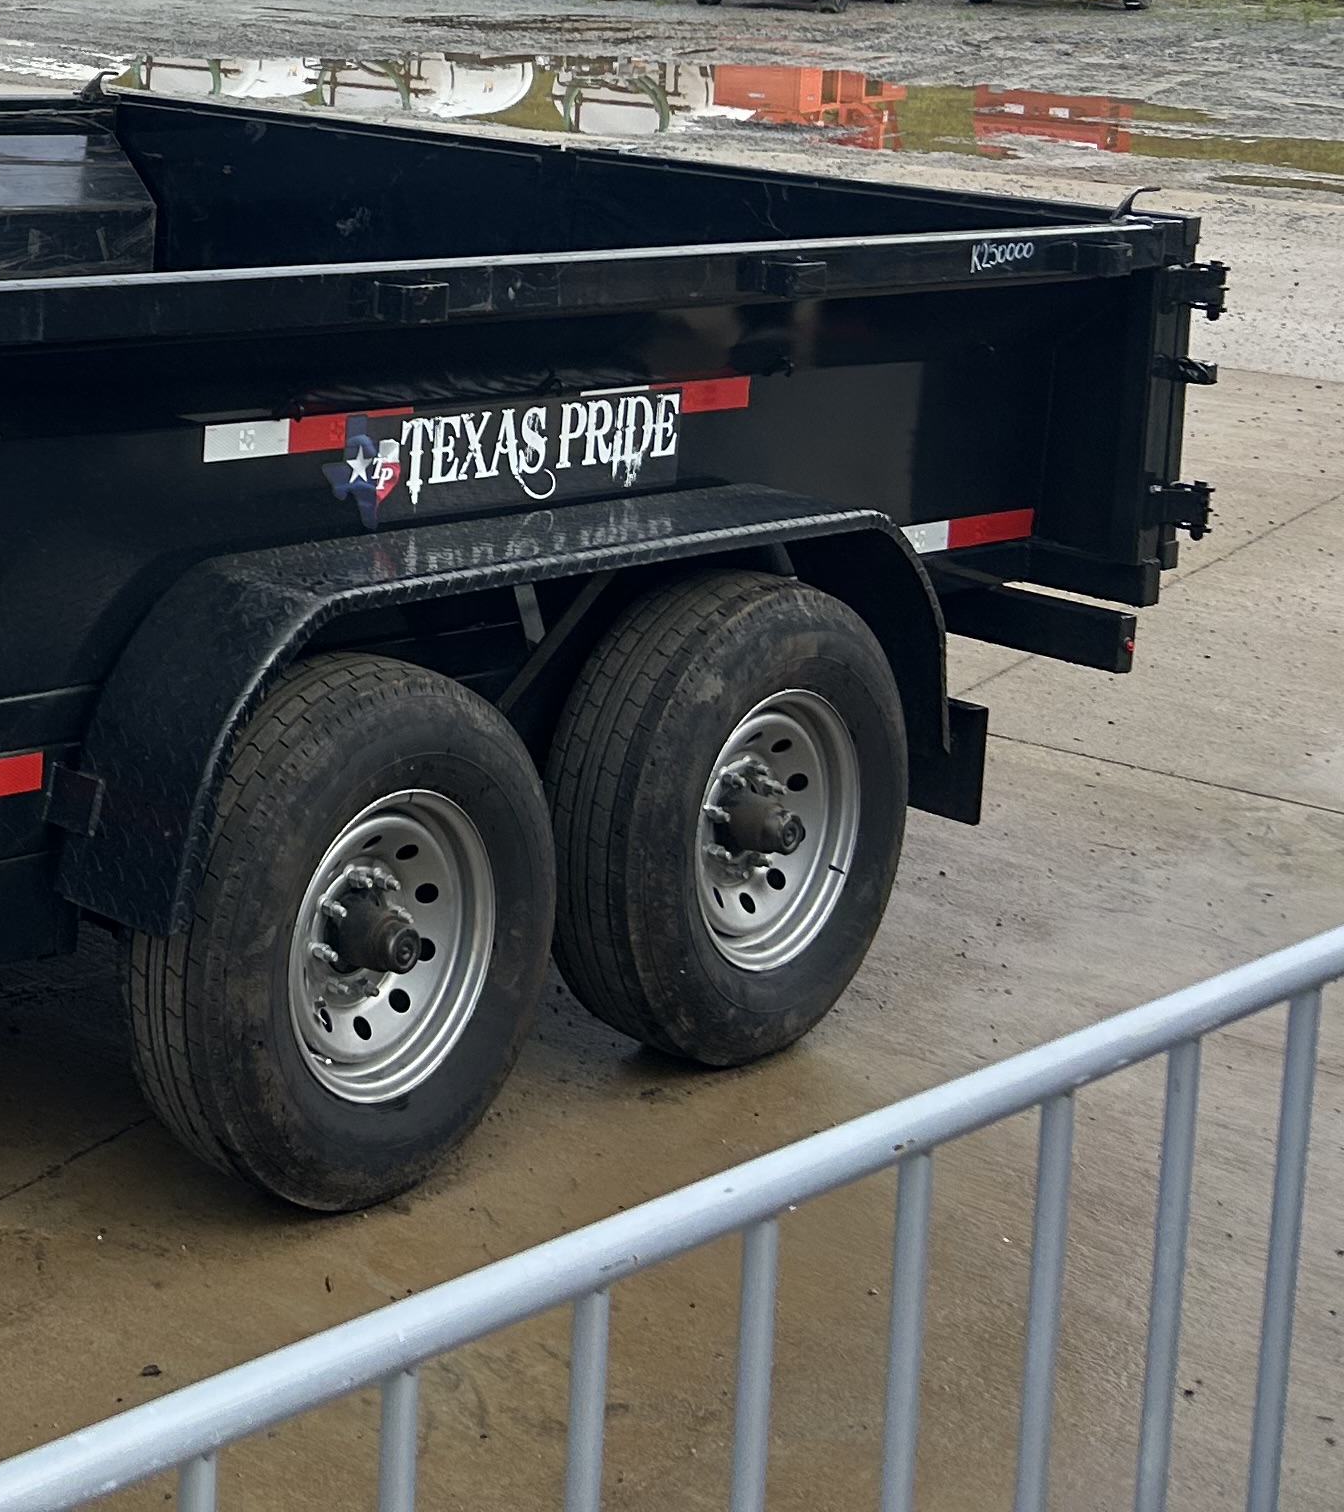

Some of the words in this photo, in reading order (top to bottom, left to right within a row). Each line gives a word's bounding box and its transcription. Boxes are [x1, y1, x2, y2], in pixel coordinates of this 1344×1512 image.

[970, 241, 1035, 273] K250000
[401, 406, 556, 504] TEXAS
[555, 393, 680, 487] PRIDE
[371, 454, 394, 490] TP
